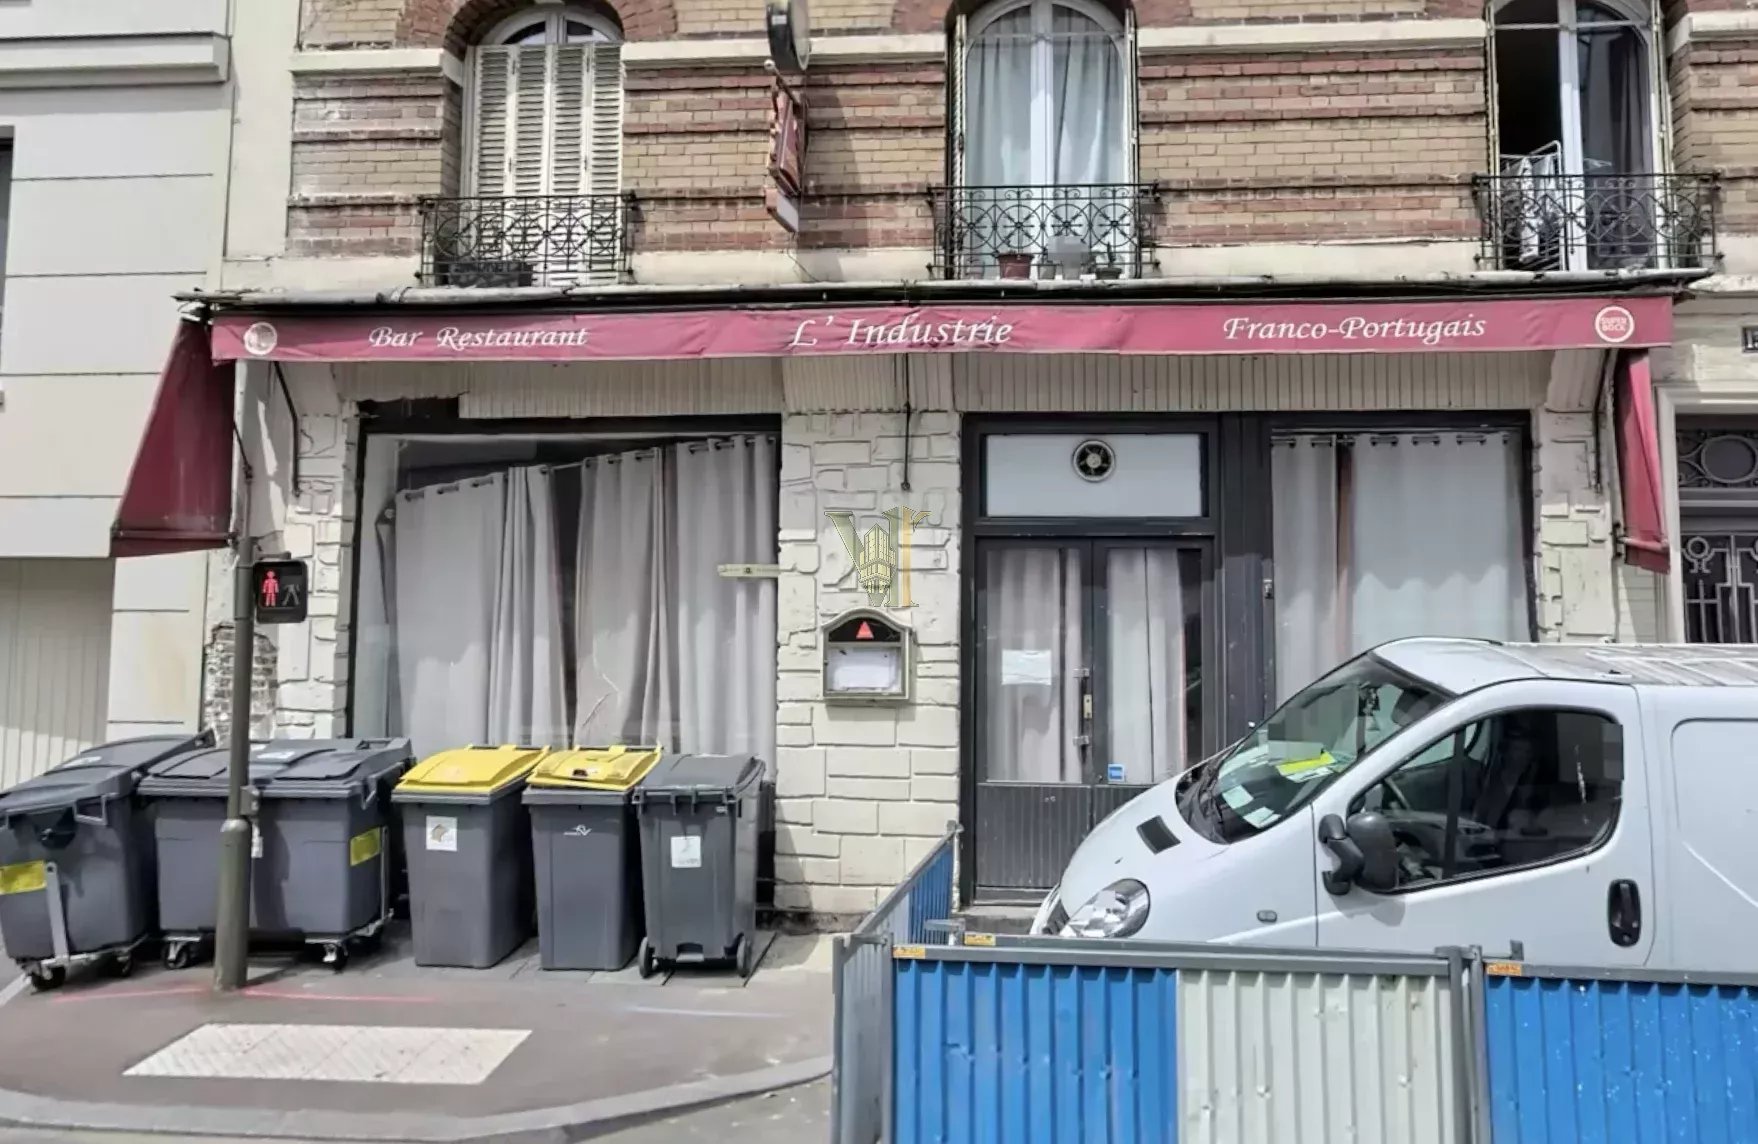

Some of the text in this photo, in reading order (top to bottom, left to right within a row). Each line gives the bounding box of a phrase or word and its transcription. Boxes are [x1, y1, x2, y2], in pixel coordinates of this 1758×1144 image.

[369, 326, 588, 351] Bar Restaurant
[844, 313, 1013, 345] Industrie
[1223, 313, 1487, 345] Franco-Portugais
